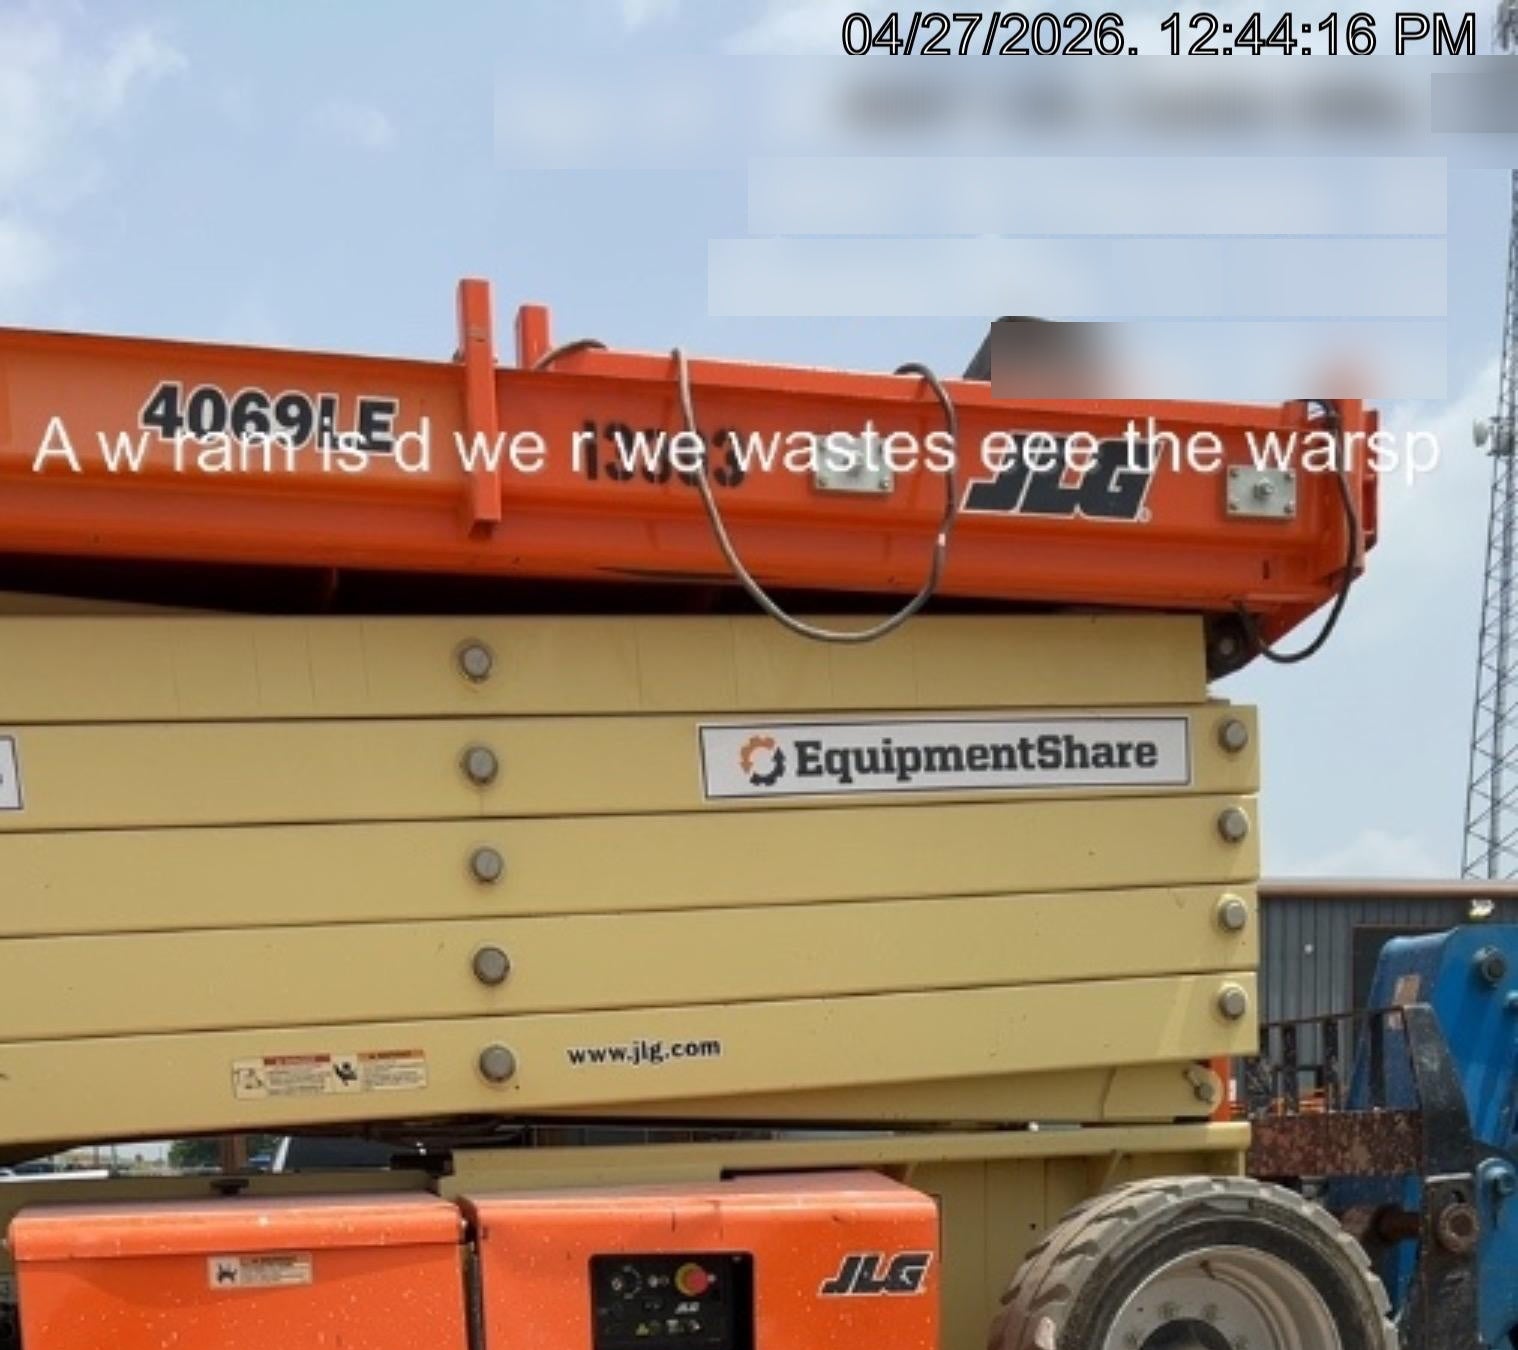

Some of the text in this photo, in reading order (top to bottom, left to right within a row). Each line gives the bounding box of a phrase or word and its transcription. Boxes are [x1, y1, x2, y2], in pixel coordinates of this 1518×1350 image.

[139, 380, 399, 457] 4069LE
[959, 430, 1164, 522] JLG
[794, 734, 1159, 784] EquipmentShare
[567, 1040, 721, 1065] www.jlg.com
[817, 1251, 933, 1296] JLG
